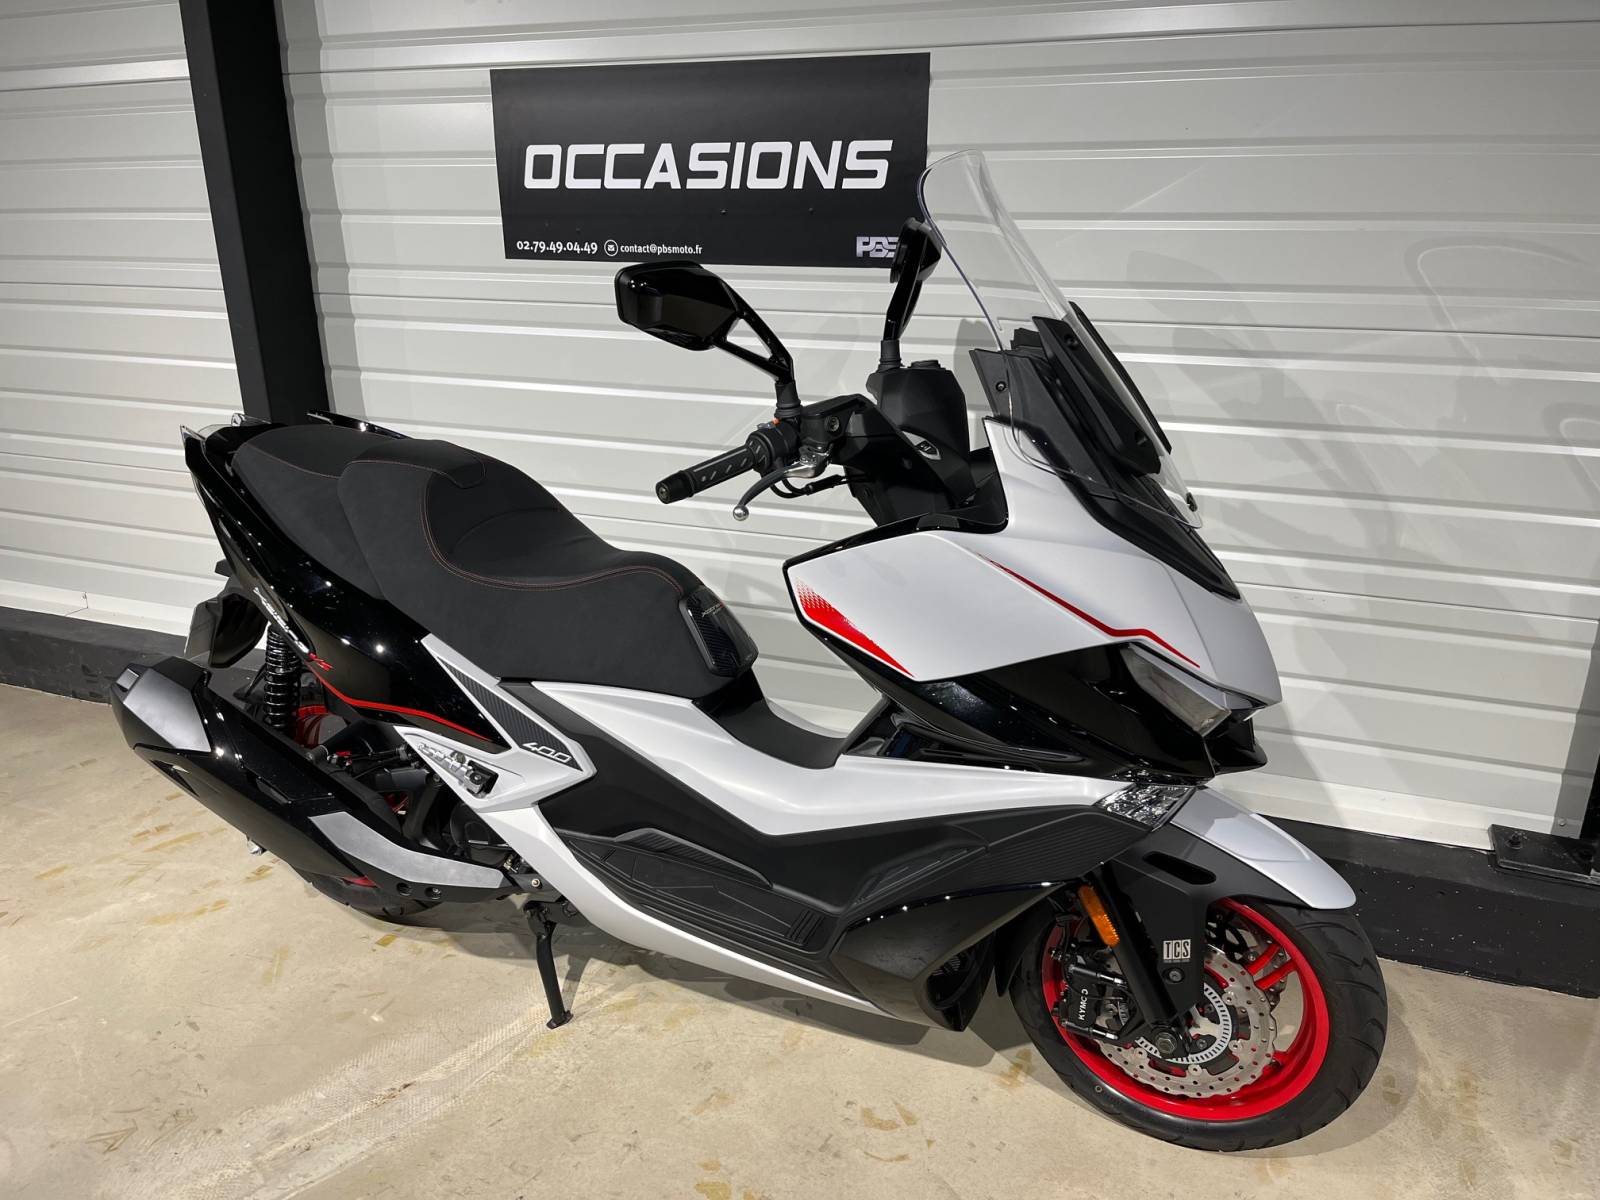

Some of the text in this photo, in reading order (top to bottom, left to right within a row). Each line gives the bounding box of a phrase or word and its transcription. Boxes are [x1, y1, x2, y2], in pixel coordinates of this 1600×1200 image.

[523, 139, 893, 190] OCCASIONS
[516, 240, 598, 254] 02.79.49.04.49
[620, 244, 703, 256] contact@pbsmoto.fr
[522, 742, 572, 763] 400
[1164, 940, 1190, 959] TCS
